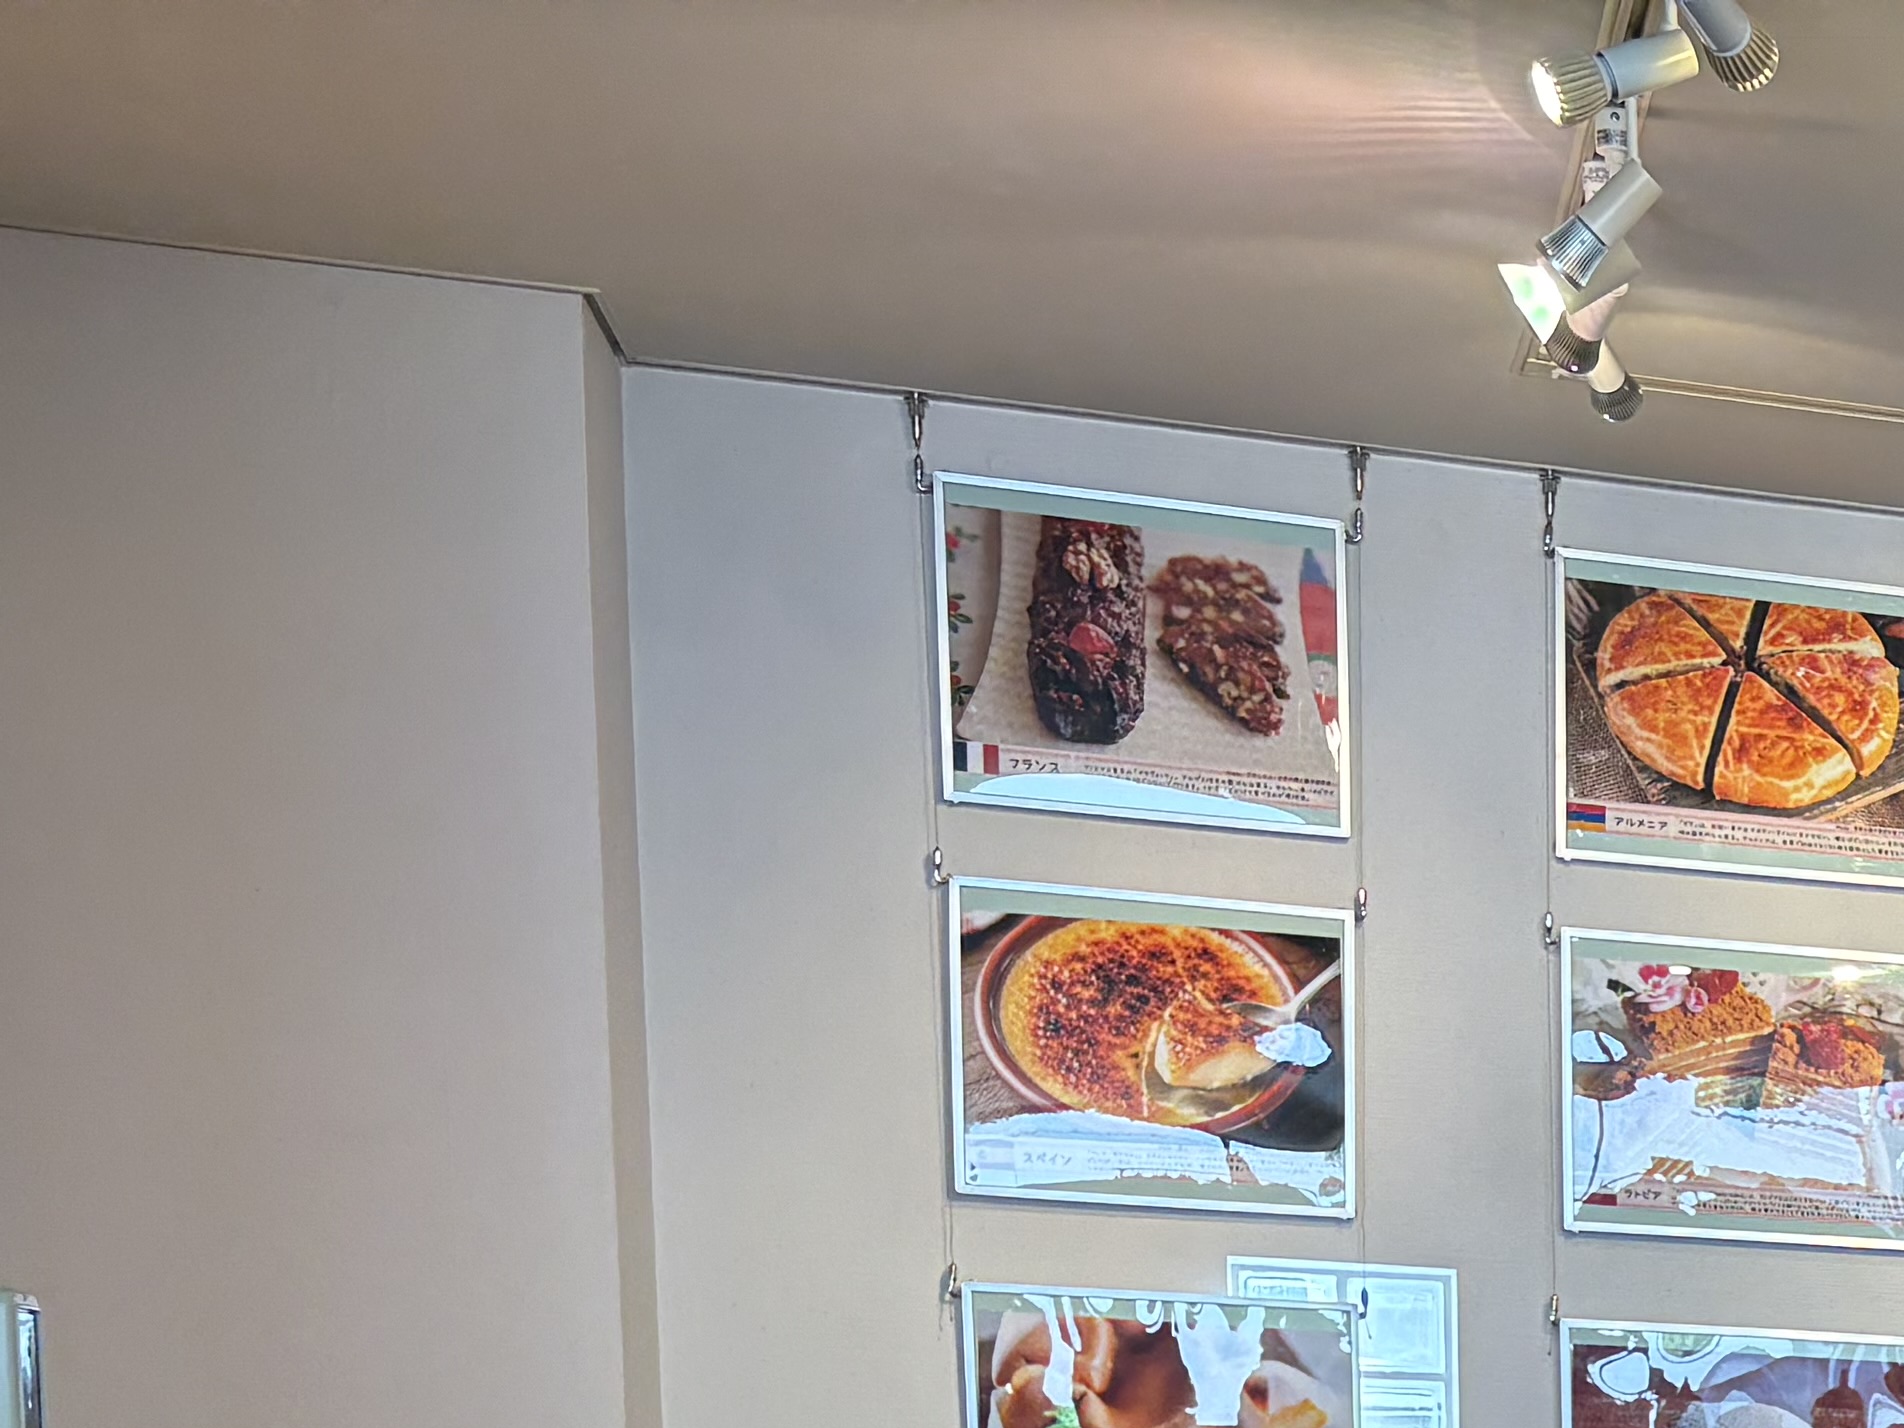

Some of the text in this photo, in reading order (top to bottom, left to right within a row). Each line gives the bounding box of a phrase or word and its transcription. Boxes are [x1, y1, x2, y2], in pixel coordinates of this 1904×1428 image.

[1008, 758, 1061, 774] フランス
[1614, 816, 1669, 831] アルメニア
[1022, 1151, 1073, 1167] スペイン
